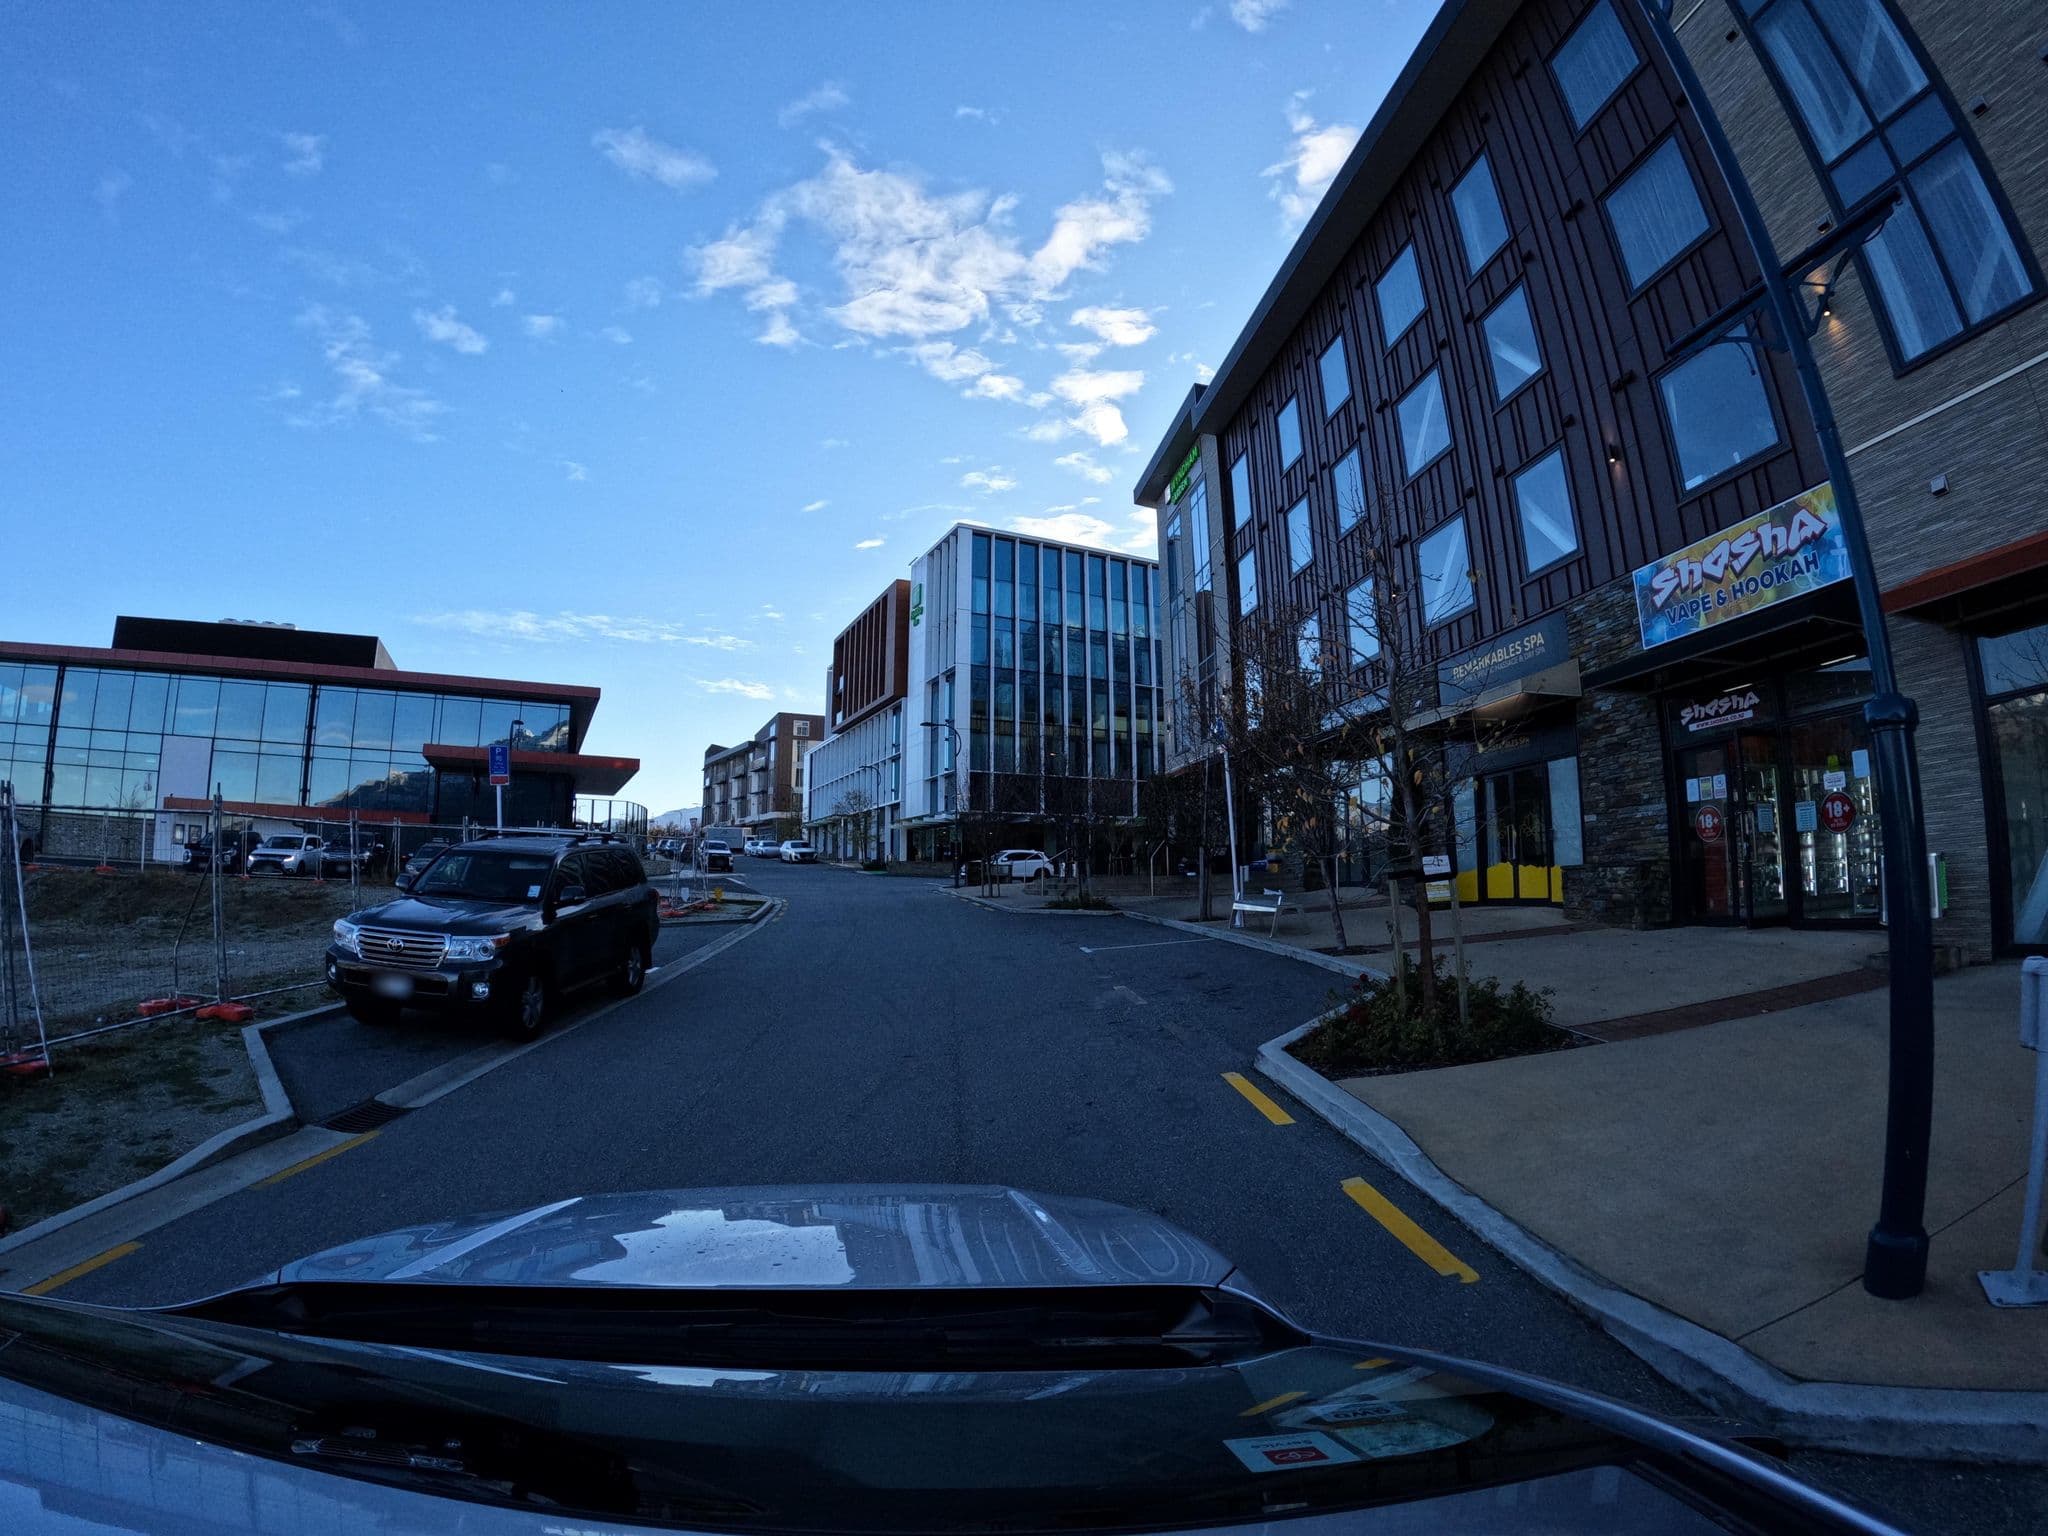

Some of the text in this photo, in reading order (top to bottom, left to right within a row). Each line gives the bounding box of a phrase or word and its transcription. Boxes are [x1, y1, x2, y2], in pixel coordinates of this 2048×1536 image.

[1666, 551, 1820, 625] VAPE & HOOKAH
[1453, 641, 1522, 680] REMARKABLES
[1523, 632, 1545, 651] SPA
[1699, 814, 1719, 829] 18+
[1825, 800, 1850, 818] 18+
